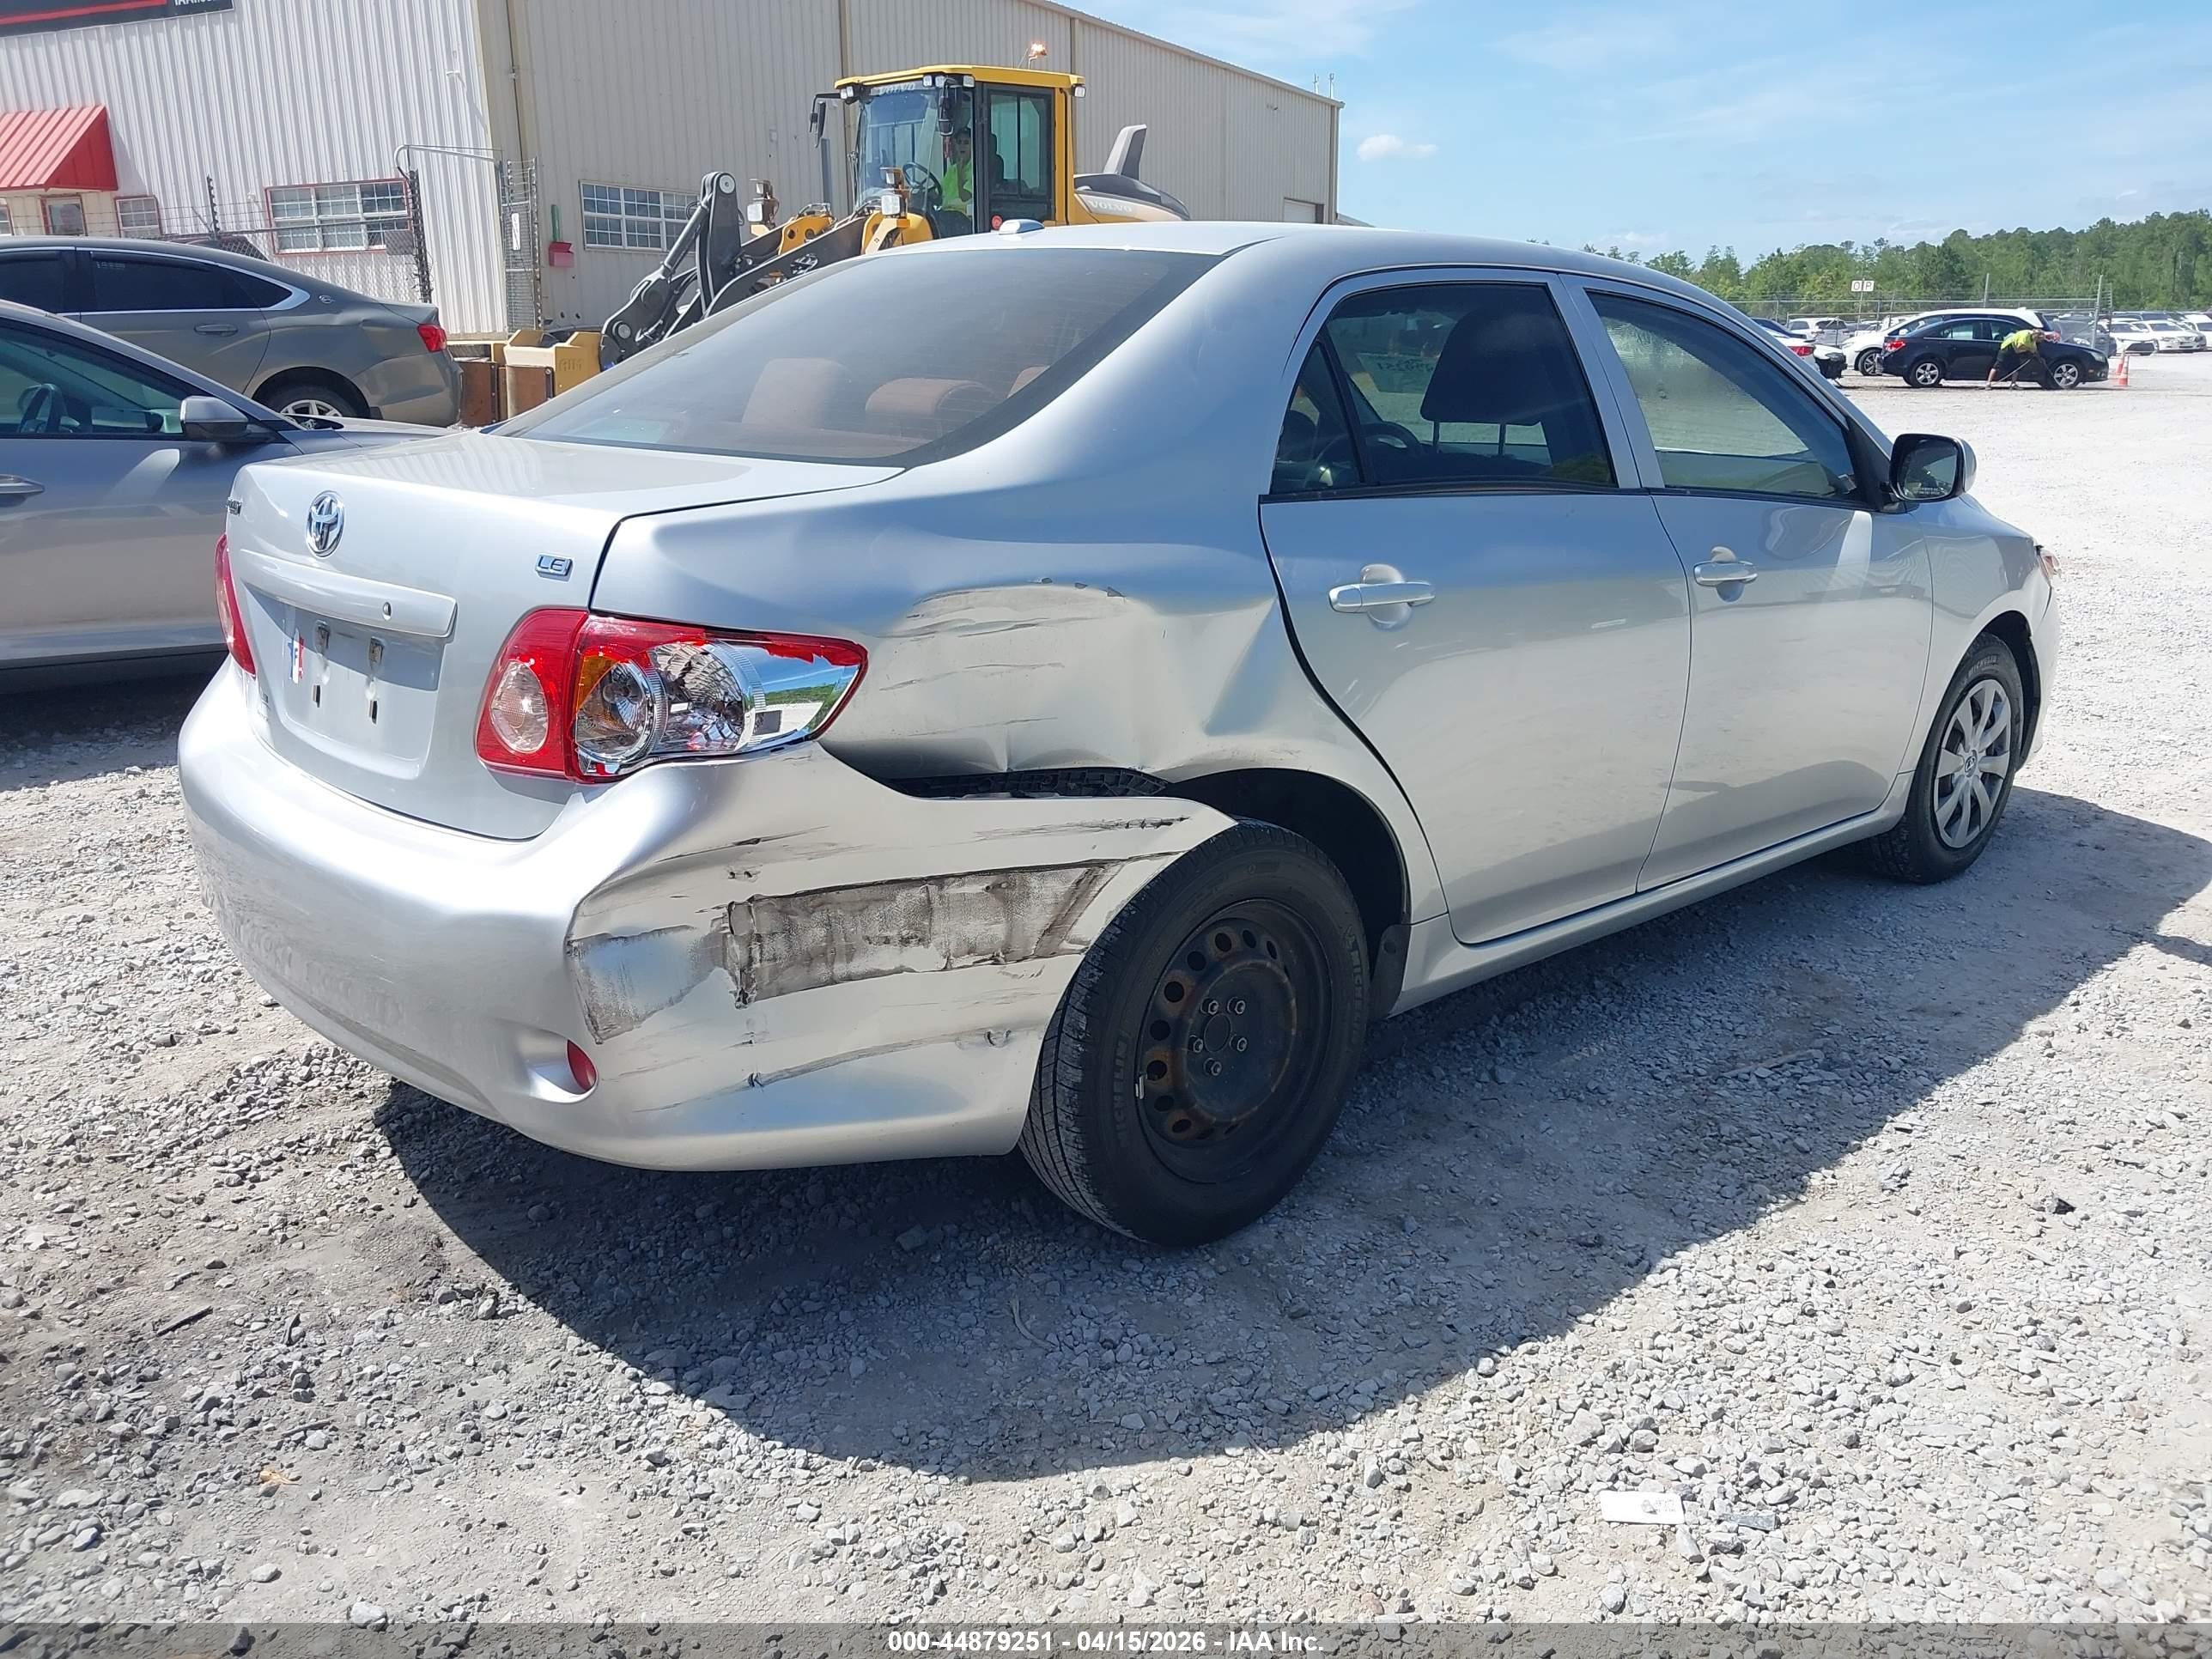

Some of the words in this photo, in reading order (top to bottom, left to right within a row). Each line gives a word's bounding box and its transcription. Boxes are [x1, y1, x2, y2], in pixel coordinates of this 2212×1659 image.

[1087, 199, 1133, 212] VOLVO
[537, 555, 567, 573] LE
[1113, 1040, 1128, 1148] MICHELIN
